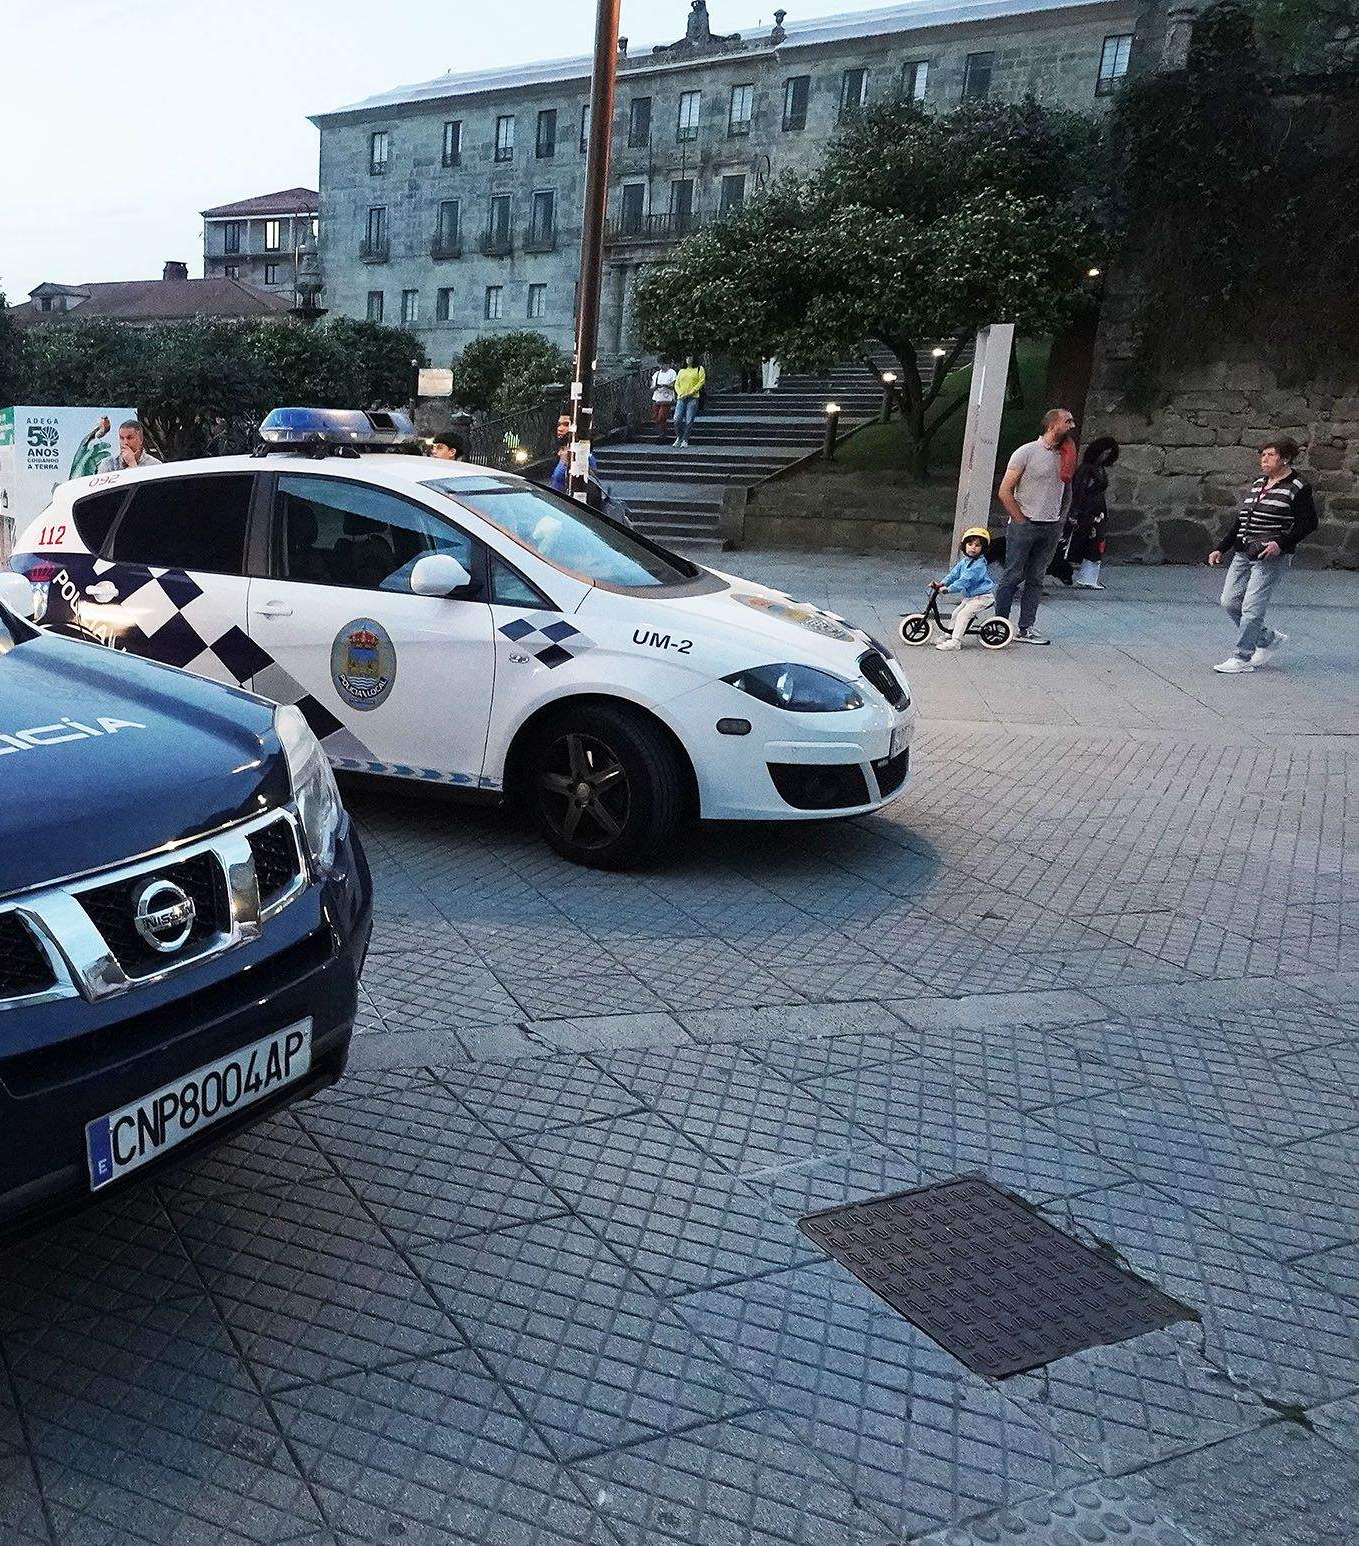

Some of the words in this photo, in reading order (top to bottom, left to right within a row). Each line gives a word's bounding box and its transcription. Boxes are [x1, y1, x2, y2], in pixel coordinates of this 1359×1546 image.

[26, 417, 59, 425] ADEGA
[27, 448, 60, 458] ANOS
[88, 474, 120, 488] 092
[38, 525, 66, 546] 112
[631, 628, 694, 655] UM-2
[366, 680, 388, 698] LOCAL
[112, 1031, 304, 1166] CNP8004AP
[98, 1158, 108, 1175] E
